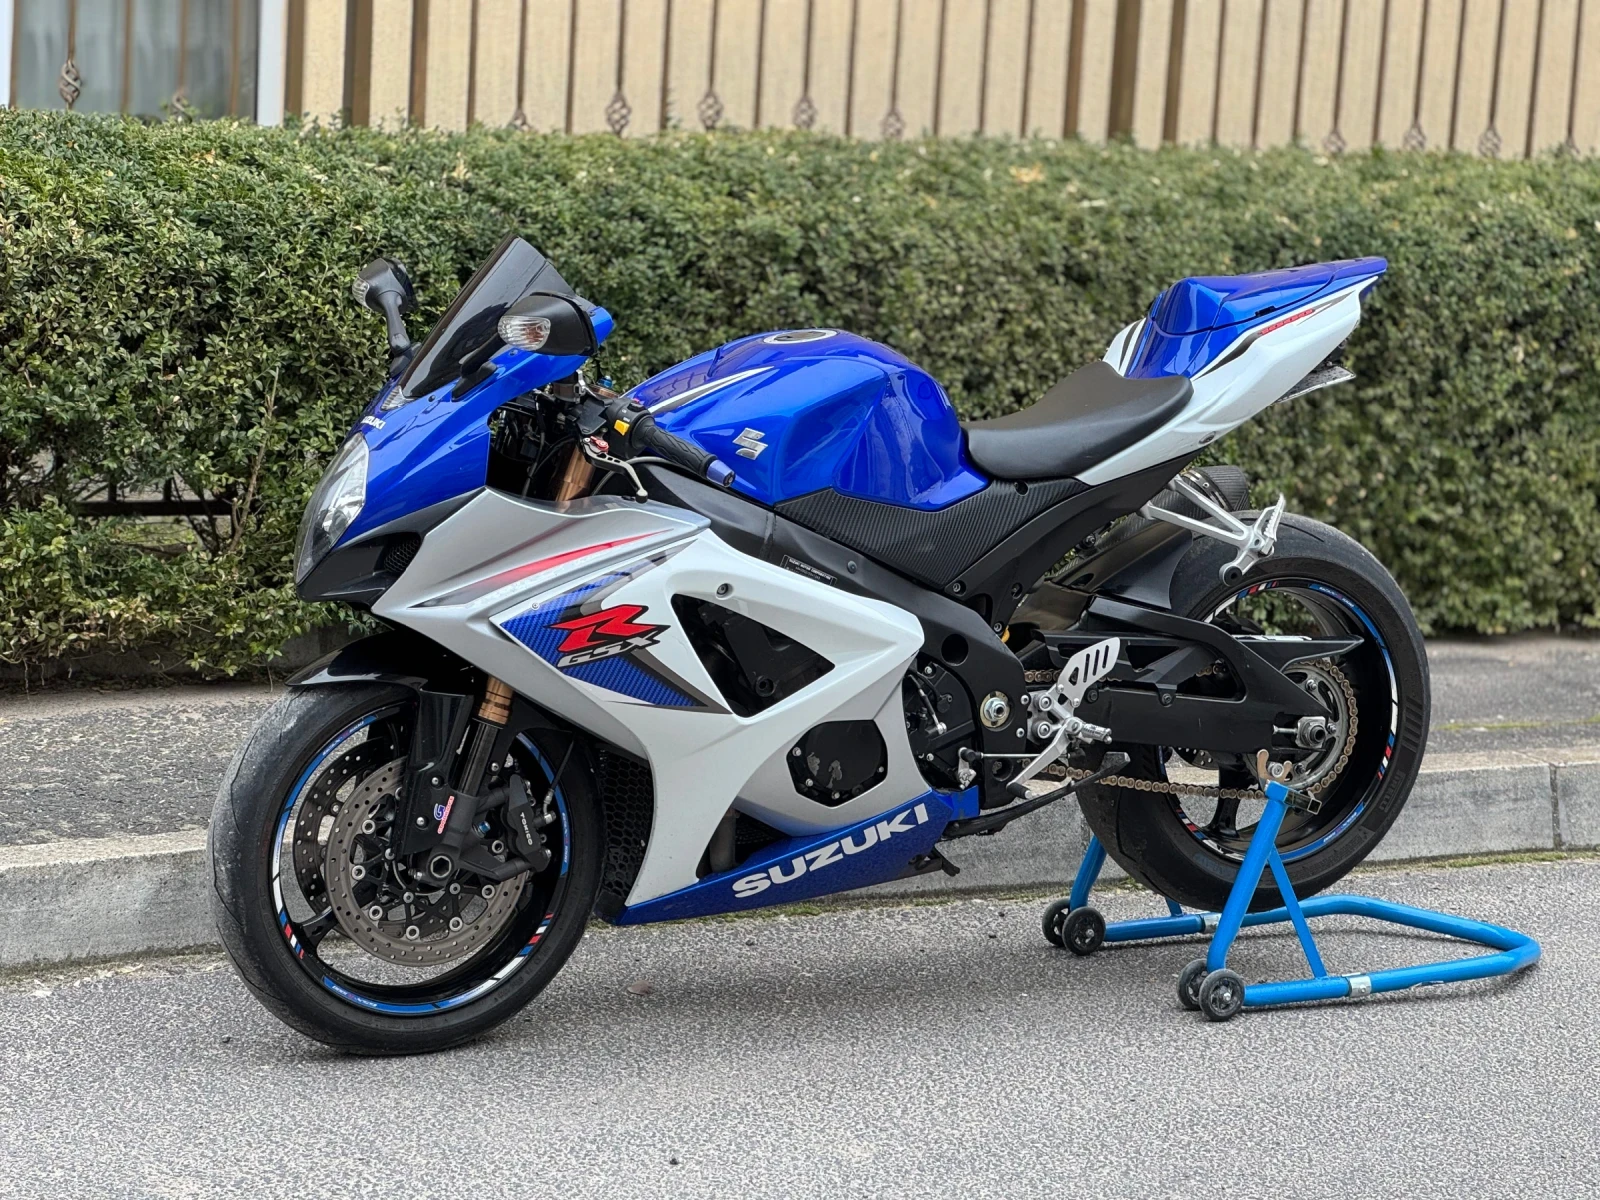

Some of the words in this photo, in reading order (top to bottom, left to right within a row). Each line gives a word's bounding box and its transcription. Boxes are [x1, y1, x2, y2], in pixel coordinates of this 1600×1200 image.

[551, 604, 659, 652] R
[557, 630, 661, 668] GSX
[520, 811, 533, 846] TOKICO
[732, 802, 929, 899] SUZUKI
